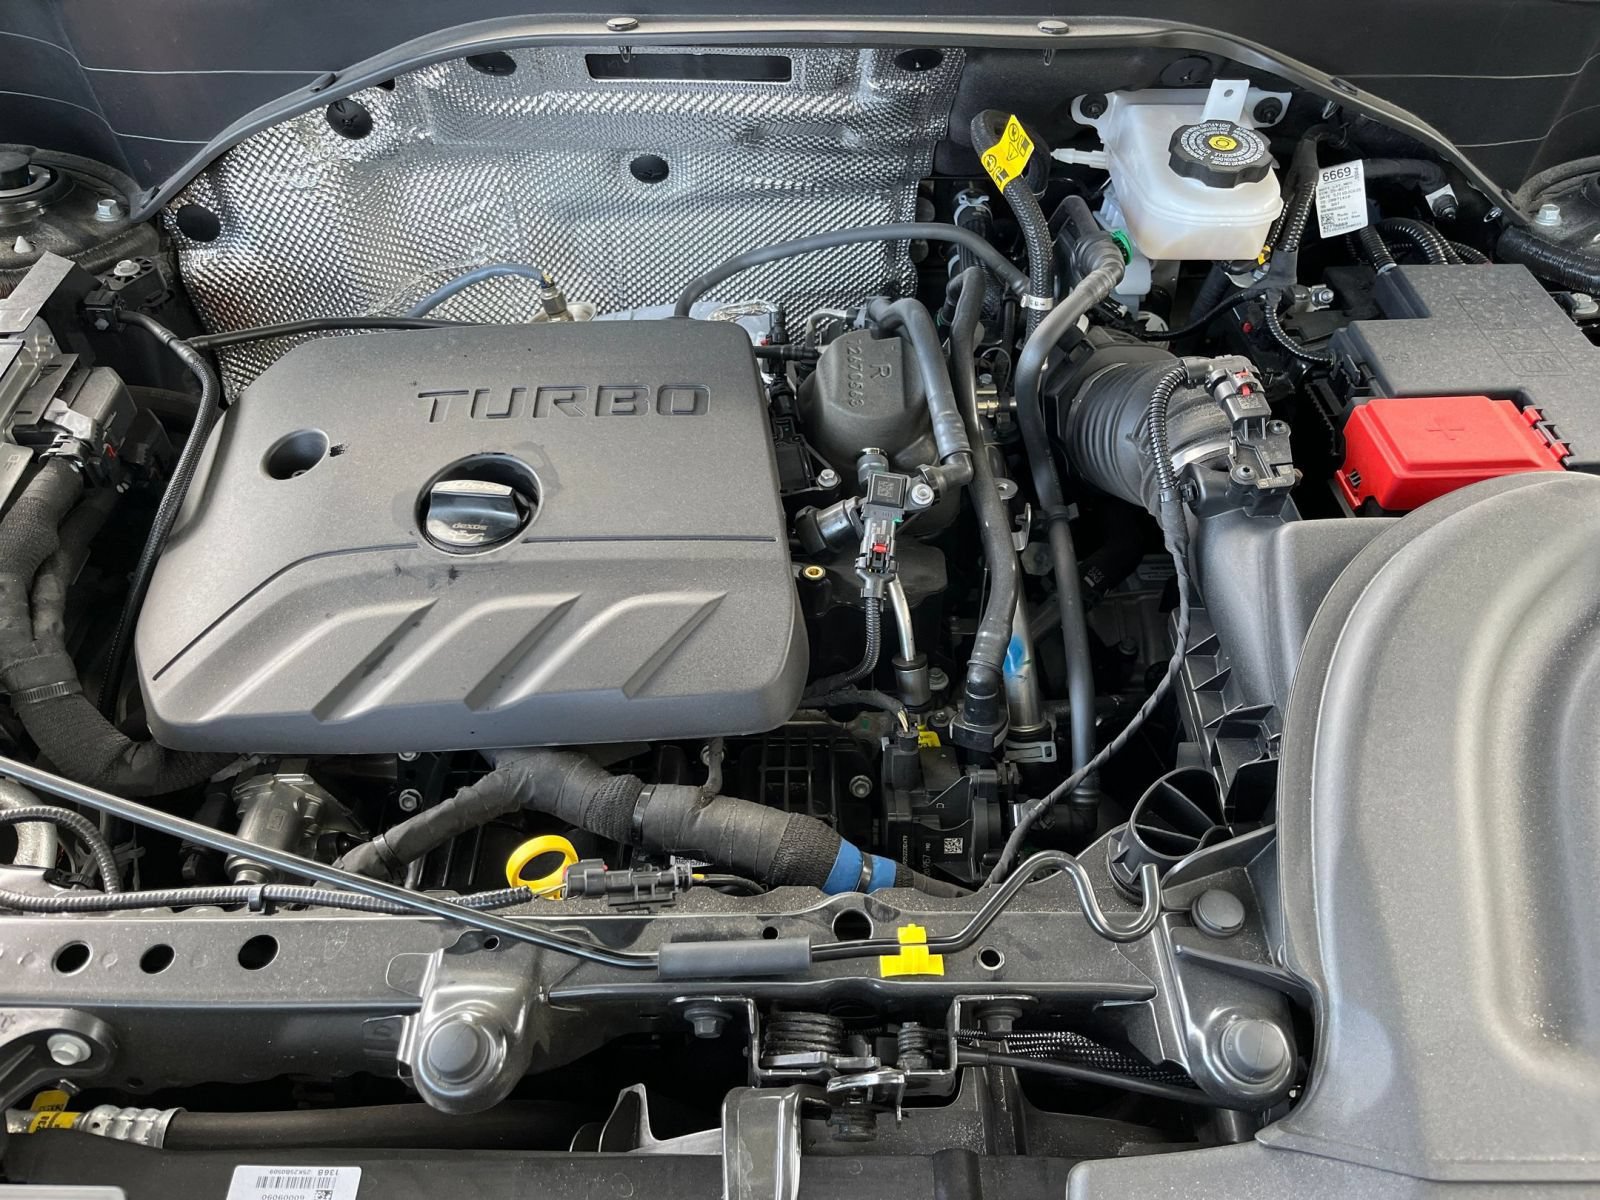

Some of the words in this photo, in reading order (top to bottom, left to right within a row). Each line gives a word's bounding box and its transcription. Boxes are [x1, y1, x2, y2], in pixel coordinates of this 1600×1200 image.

[1322, 166, 1351, 182] 6669
[869, 362, 892, 379] R
[417, 384, 711, 423] TURBO
[452, 522, 489, 532] dexos
